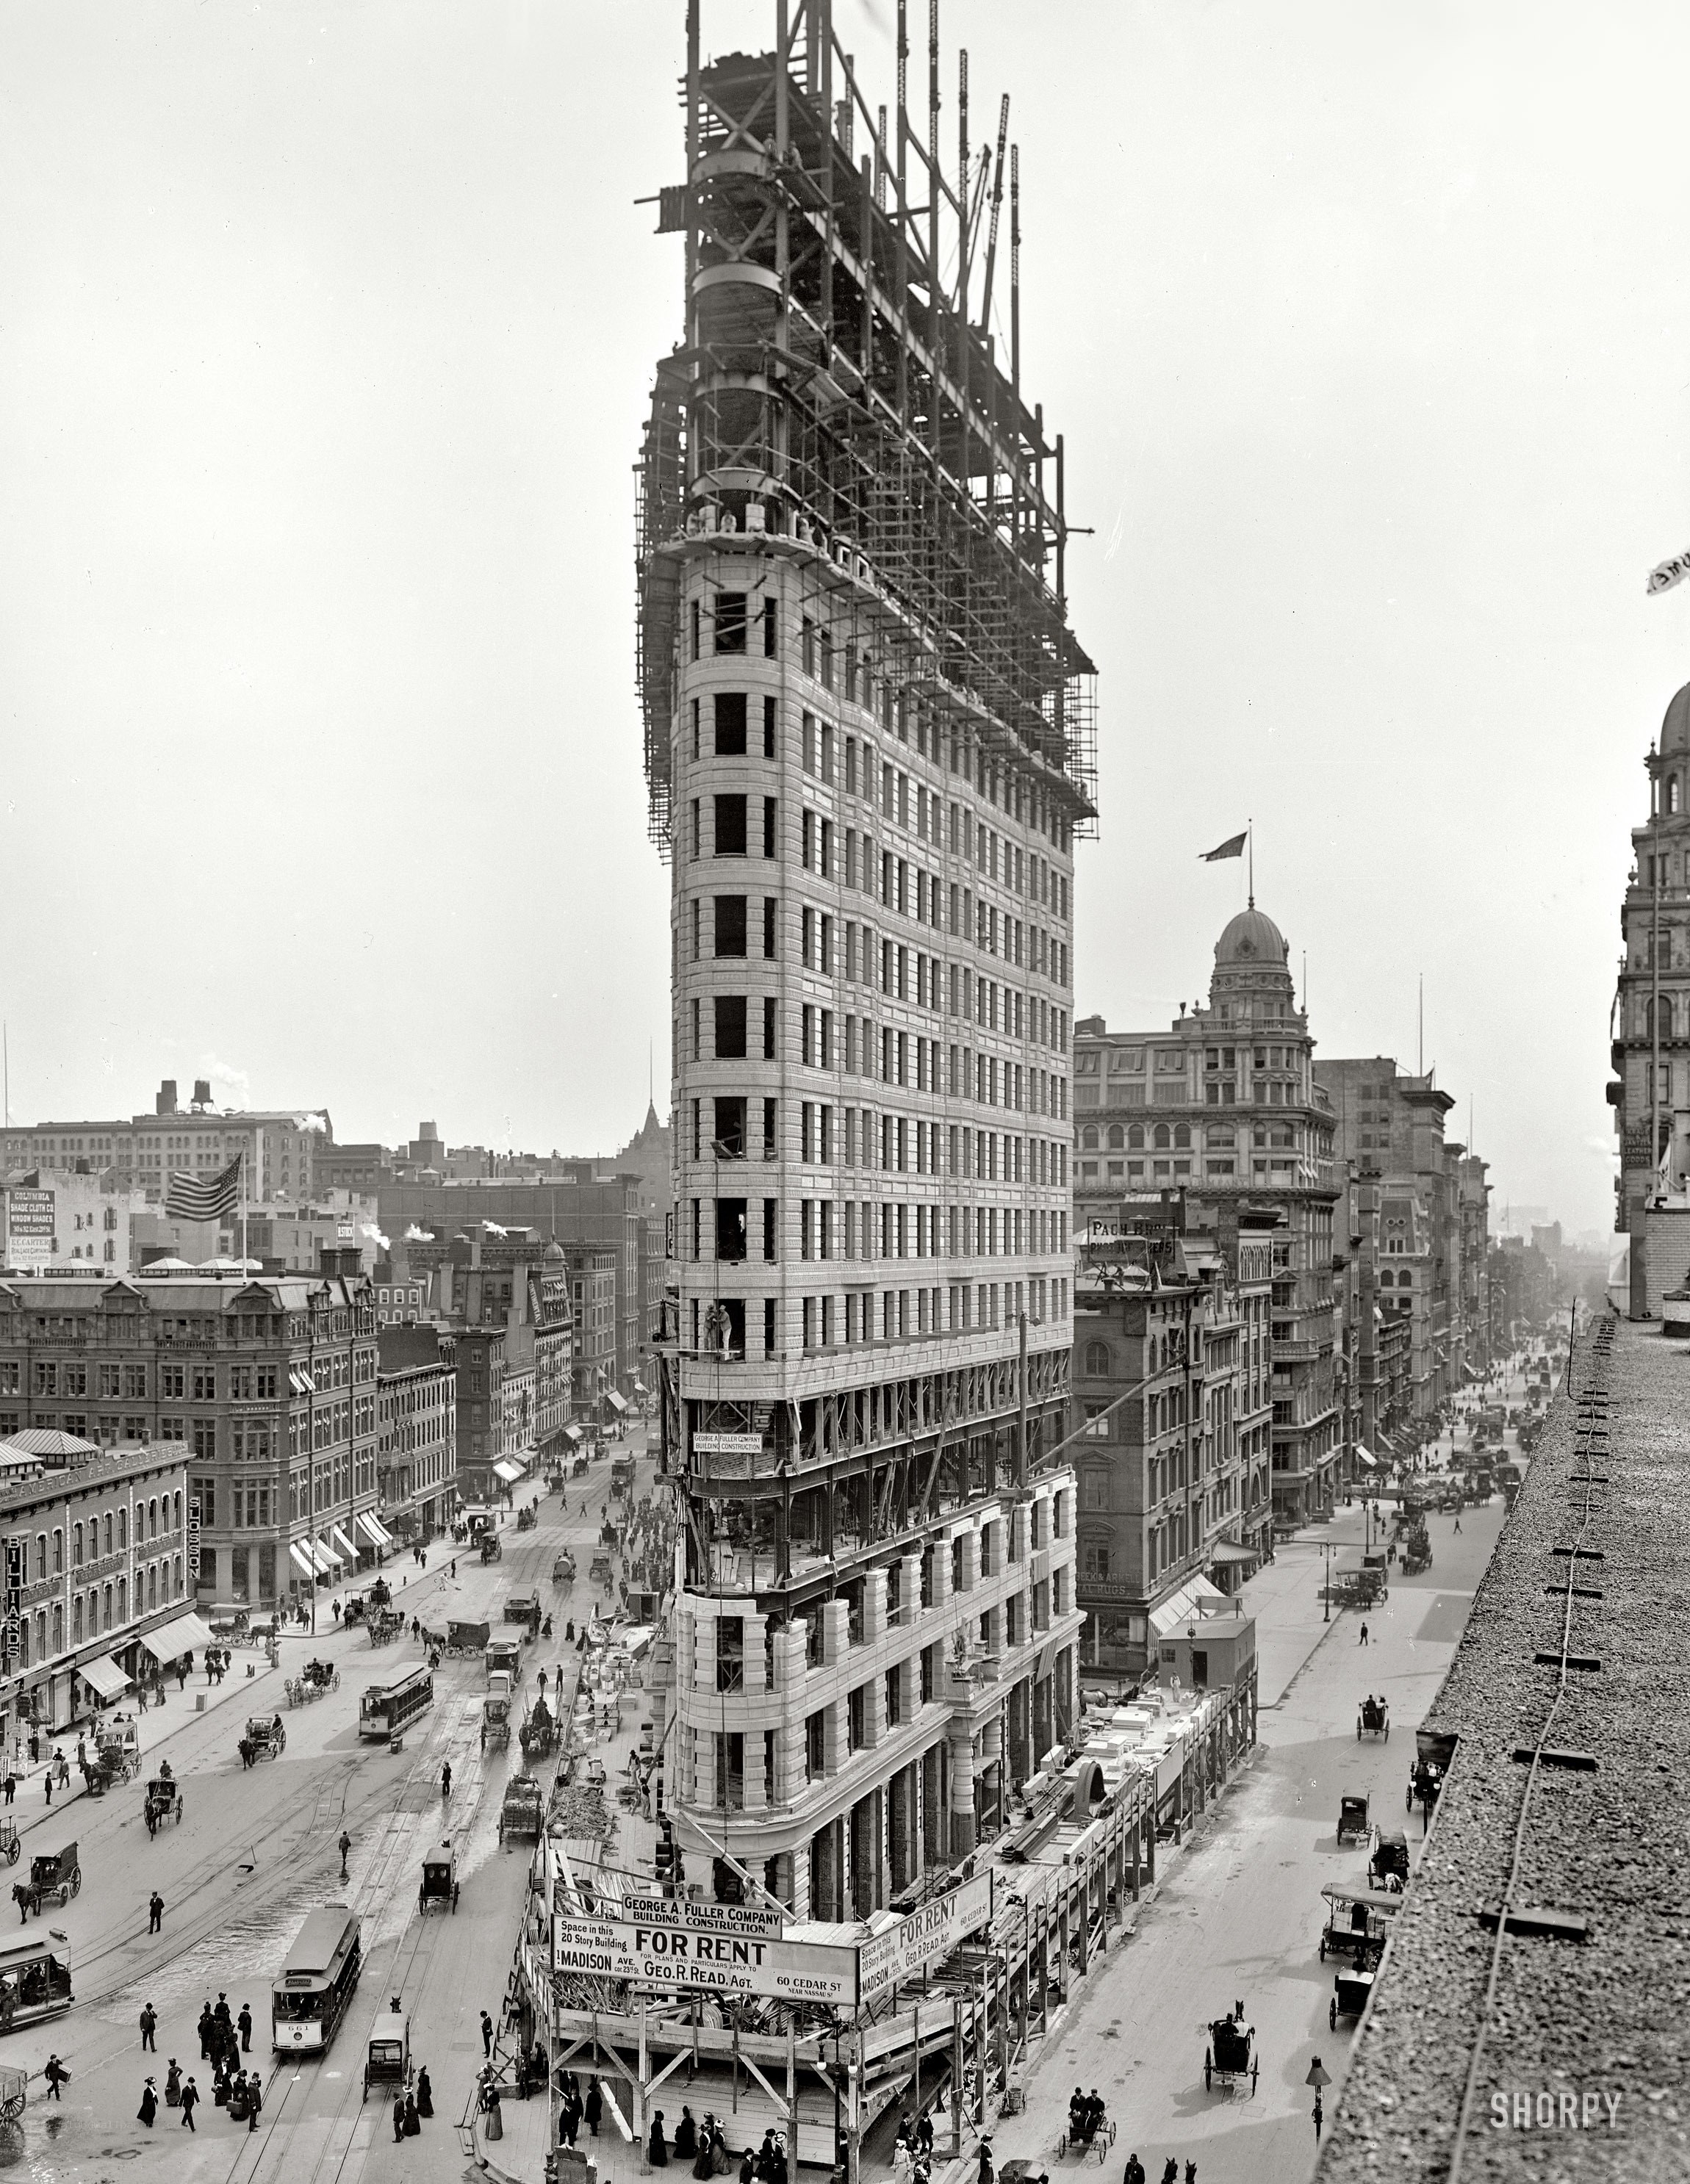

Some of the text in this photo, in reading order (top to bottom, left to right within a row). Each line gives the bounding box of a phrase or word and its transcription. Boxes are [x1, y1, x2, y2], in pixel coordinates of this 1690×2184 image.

[15, 1192, 50, 1201] COLUMBIA
[10, 1203, 29, 1212] SHADE
[29, 1203, 46, 1212] CLOTH
[11, 1214, 31, 1222] WINDOW
[1093, 1220, 1127, 1236] PACH
[528, 1279, 542, 1323] CONTINENTAL
[19, 1470, 82, 1497] AMERICAN
[88, 1463, 115, 1478] ART
[117, 1446, 173, 1471] GALLERIES
[190, 1497, 200, 1579] SLOSSON
[1076, 1571, 1140, 1583] BEEK & ARKELL
[7, 1537, 20, 1658] BILLIARDS
[1077, 1585, 1093, 1593] TAL
[624, 1896, 780, 1925] GEORGE A. FULLER COMPANY
[960, 1916, 966, 1926] 60
[968, 1906, 982, 1921] CEDAR
[561, 1920, 614, 1936] Space in this
[633, 1911, 769, 1934] BUILDING CONSTRUCTION.
[899, 1894, 957, 1948] FOR RENT
[561, 1933, 628, 1953] 20 Story Building
[636, 1929, 766, 1965] FOR RENT
[862, 1936, 891, 1960] Space in this
[561, 1950, 611, 1971] MADISON
[644, 1961, 675, 1979] GEO.
[691, 1959, 727, 1969] PARTICULARS
[862, 1961, 869, 1972] 20
[869, 1955, 880, 1969] Story
[777, 1976, 790, 1986] 60
[793, 1978, 827, 1990] CEDAR
[862, 1966, 888, 1997] MADISON
[788, 1987, 803, 1995] NEAR
[804, 1989, 826, 1997] NASSAU
